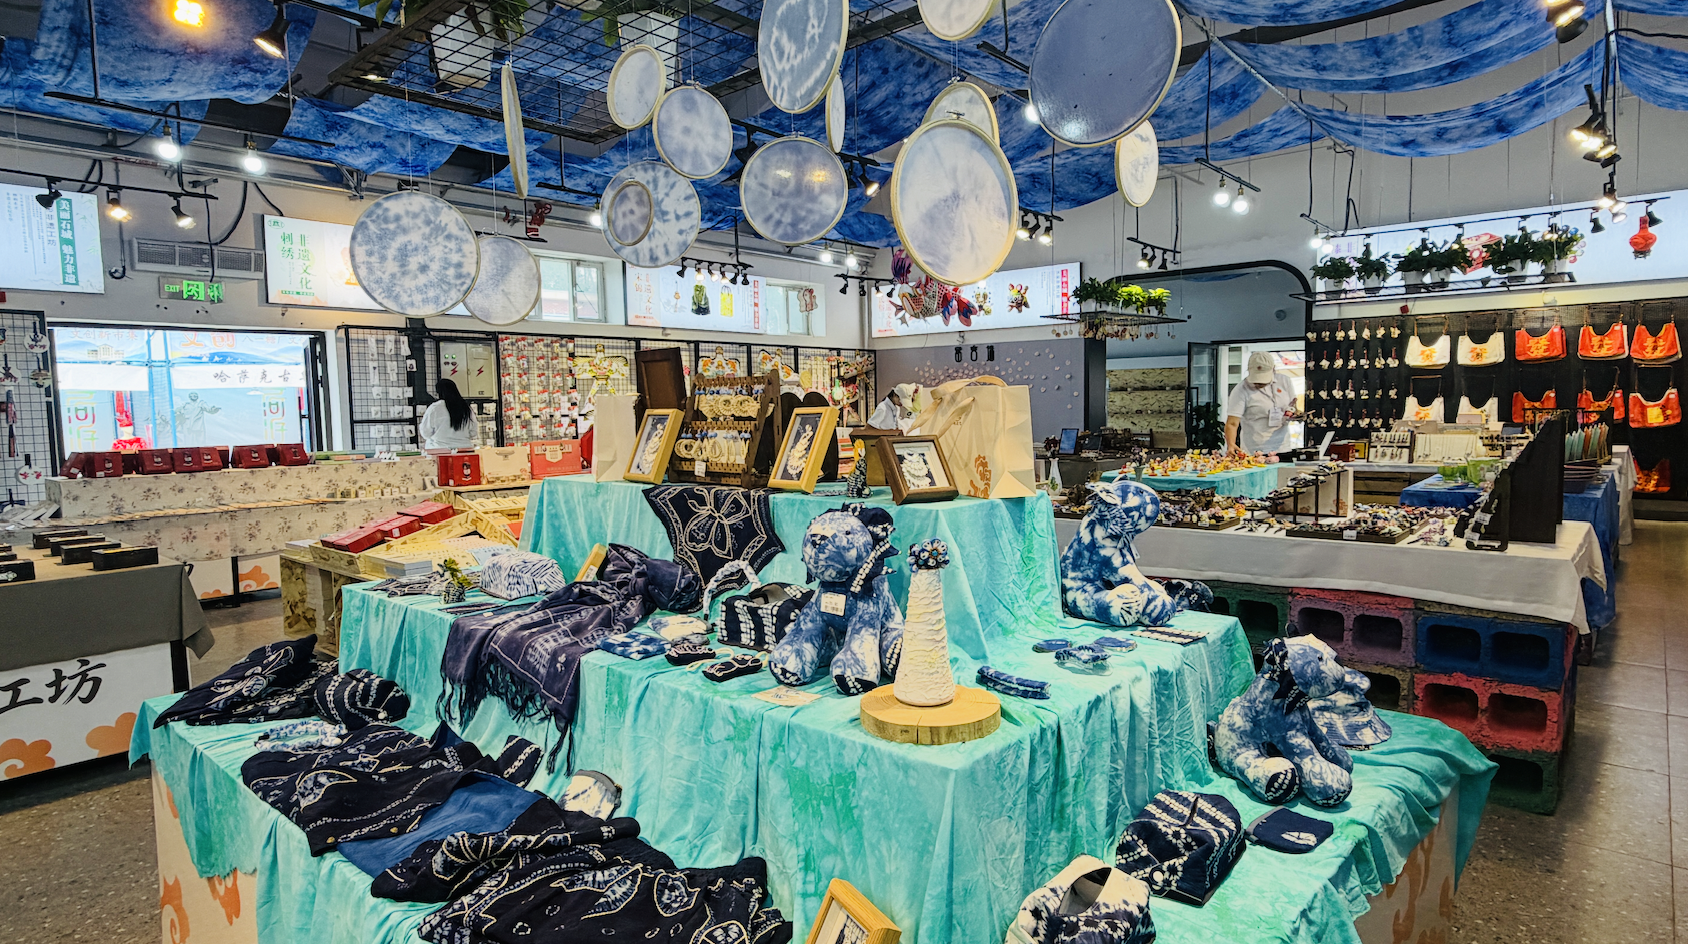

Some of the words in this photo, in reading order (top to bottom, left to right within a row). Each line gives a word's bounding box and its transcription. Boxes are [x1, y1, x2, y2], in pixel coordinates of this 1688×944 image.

[60, 199, 74, 240] 美丽石城
[61, 244, 77, 284] 魅力非遗
[280, 231, 295, 260] 刺绣
[296, 233, 317, 290] 非遗文化
[164, 284, 181, 293] EXIT
[0, 658, 107, 715] 工坊
